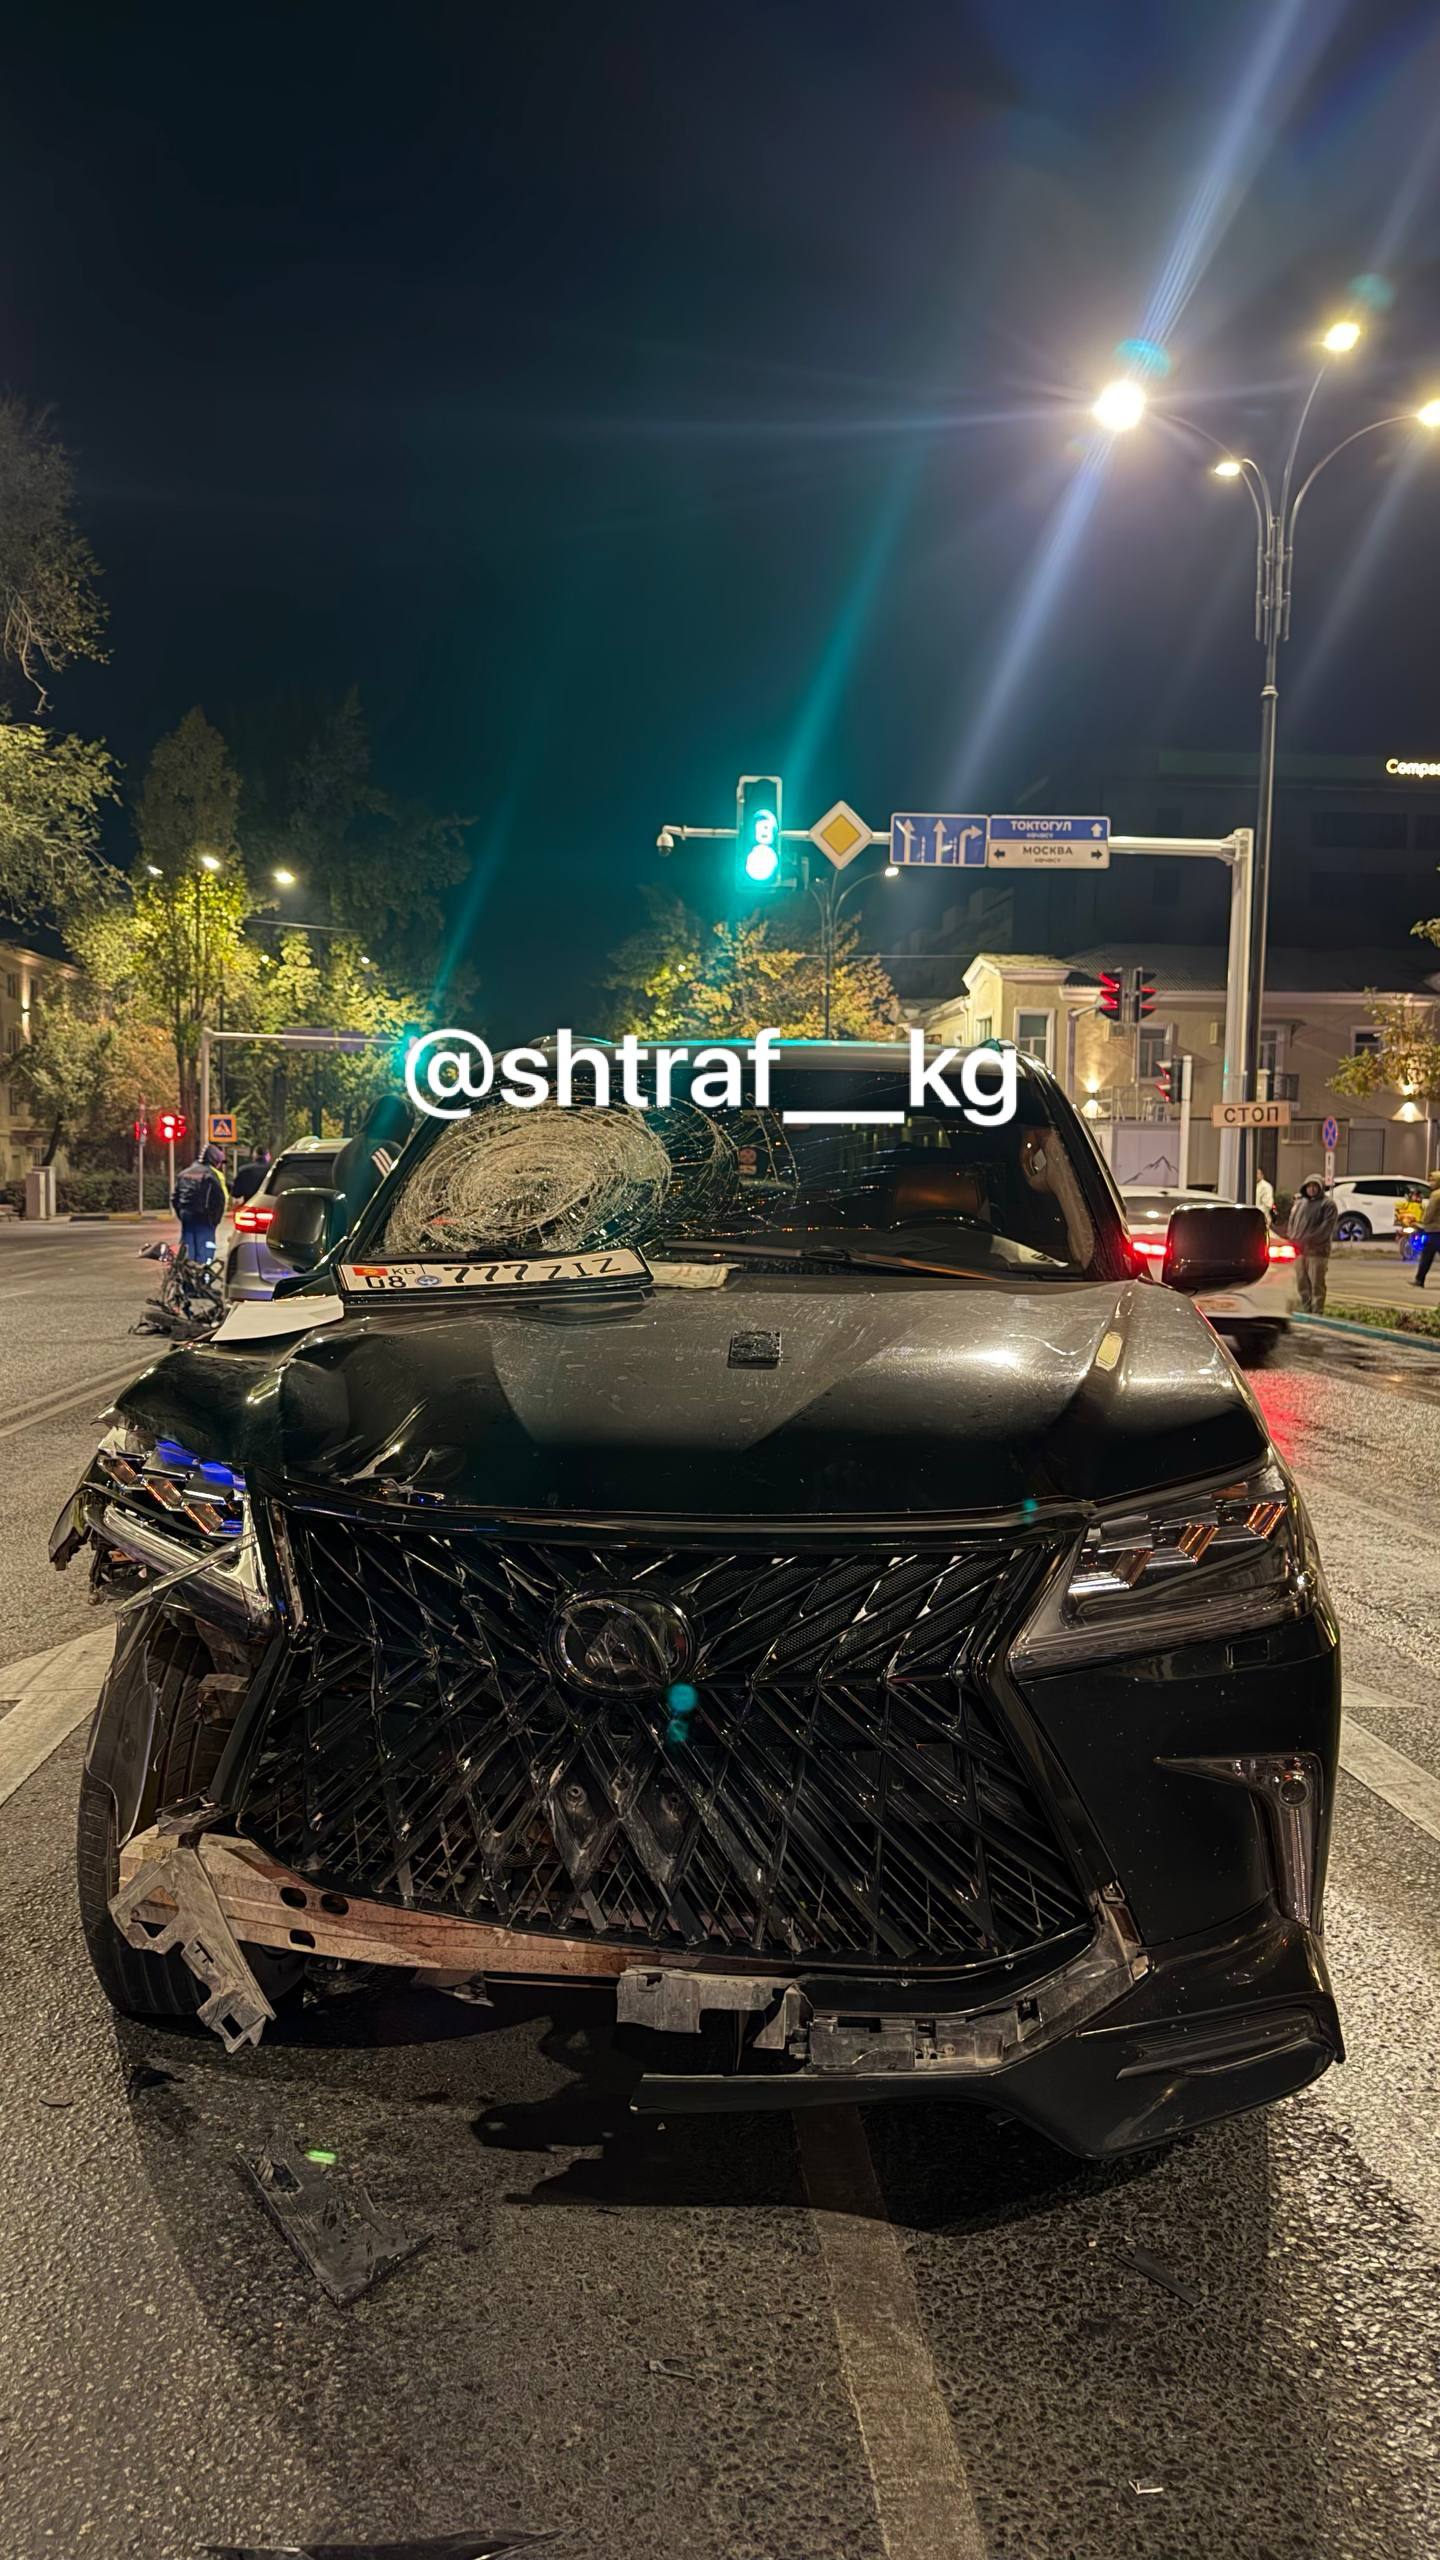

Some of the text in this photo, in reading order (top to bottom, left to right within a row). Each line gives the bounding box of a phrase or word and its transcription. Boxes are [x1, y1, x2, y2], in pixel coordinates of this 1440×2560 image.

[1010, 820, 1072, 831] ТОКТОГУЛ
[1022, 846, 1073, 855] МОСКВА
[1224, 1106, 1279, 1123] СТОП
[392, 1267, 416, 1275] KG
[443, 1263, 529, 1284] 777
[365, 1275, 407, 1289] 08
